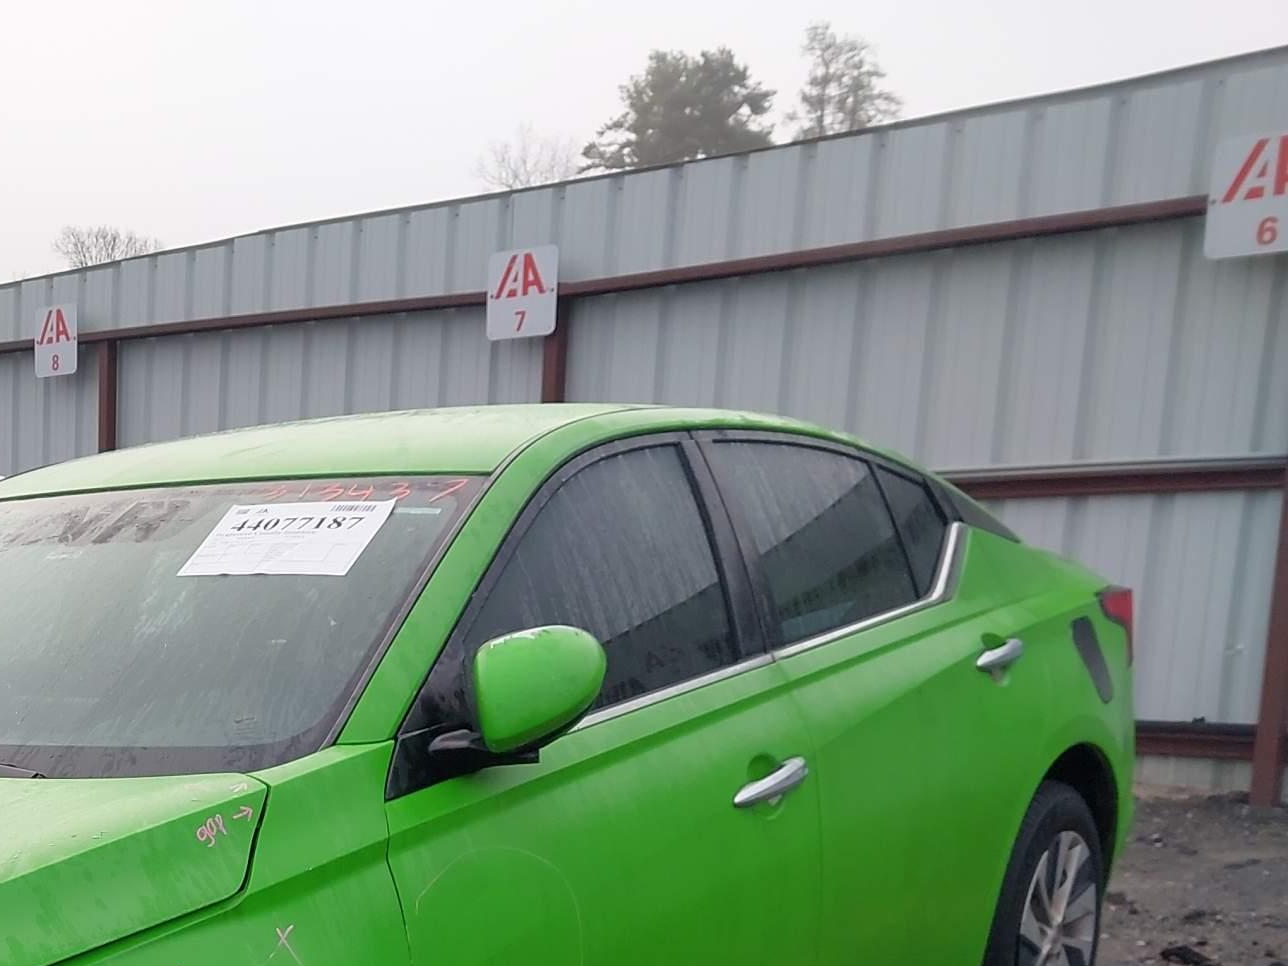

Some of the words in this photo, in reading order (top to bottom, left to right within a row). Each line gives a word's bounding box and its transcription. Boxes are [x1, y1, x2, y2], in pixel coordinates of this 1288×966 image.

[1256, 216, 1279, 246] 6
[514, 310, 527, 332] 7
[52, 354, 60, 371] 8
[231, 516, 365, 532] 44077187
